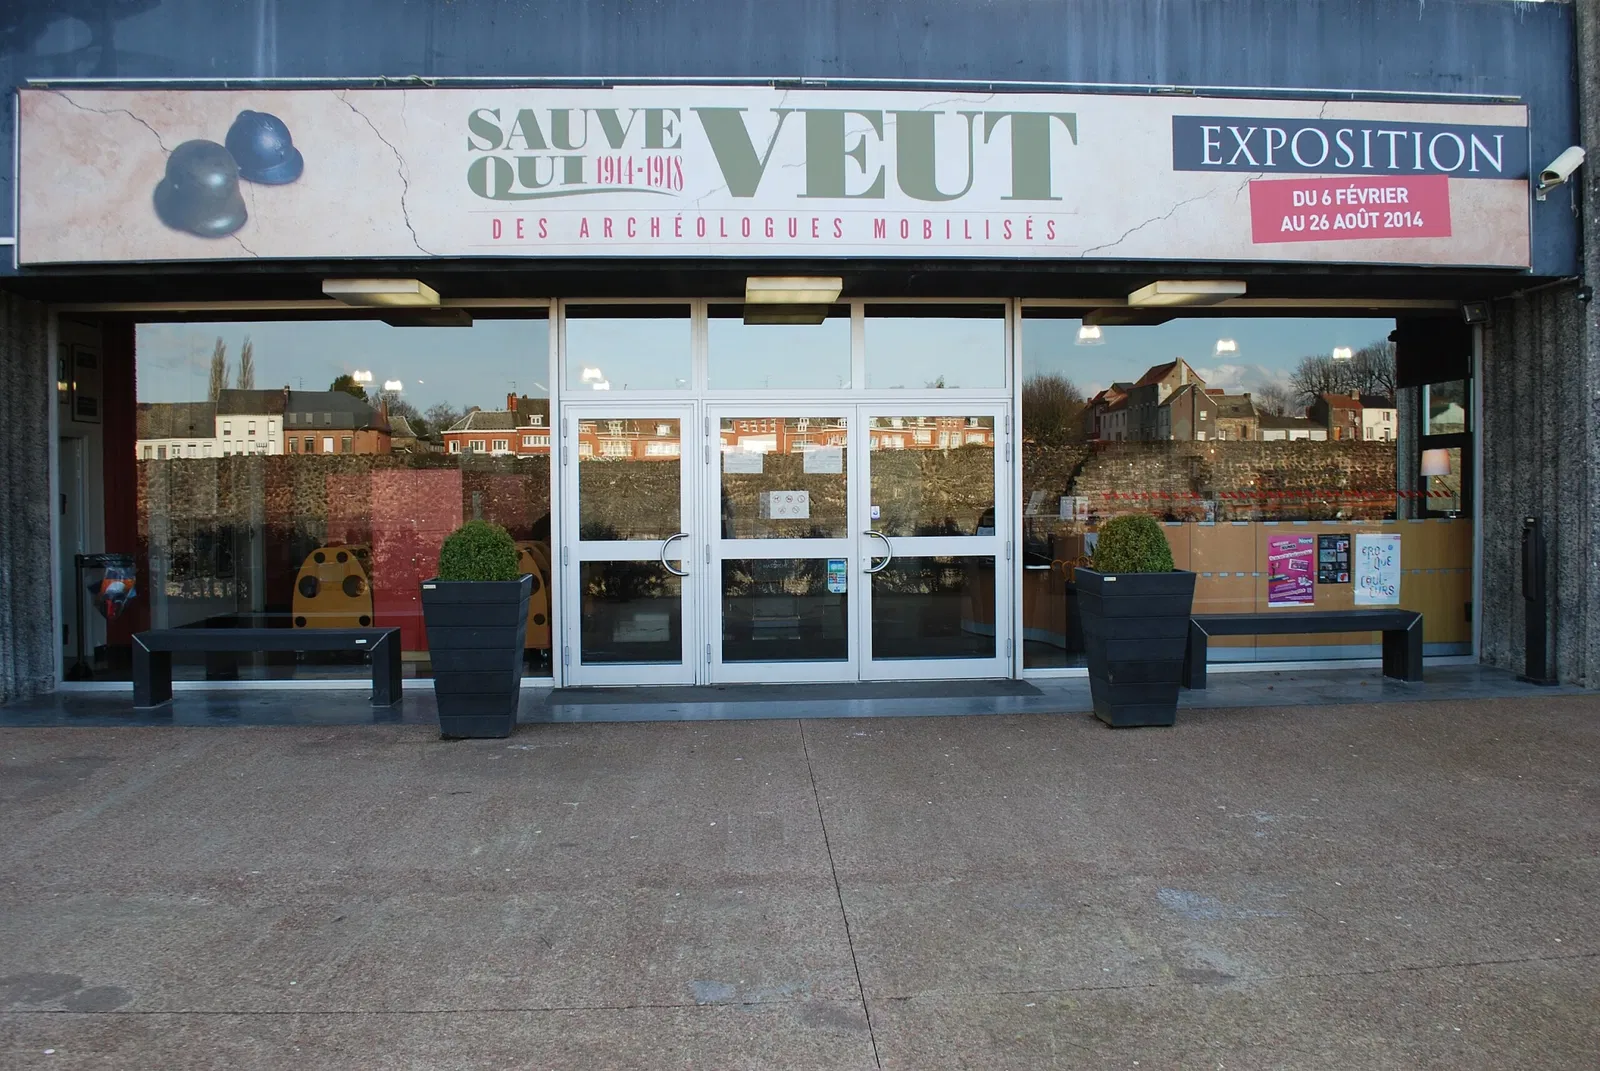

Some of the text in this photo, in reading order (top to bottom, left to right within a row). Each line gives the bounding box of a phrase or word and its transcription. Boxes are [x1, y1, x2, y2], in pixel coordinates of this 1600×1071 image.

[467, 108, 682, 151] SAUVE
[1200, 125, 1504, 173] EXPOSITION
[596, 154, 684, 192] 1914-1918
[690, 107, 1078, 202] VEUT
[467, 155, 588, 201] QUI
[1293, 184, 1409, 207] DU 6 FÉVRIER
[492, 213, 1058, 239] DES ARCHÉOLOGUES MOBILISÉS
[1280, 208, 1424, 232] AU 26 AOÛT 2014
